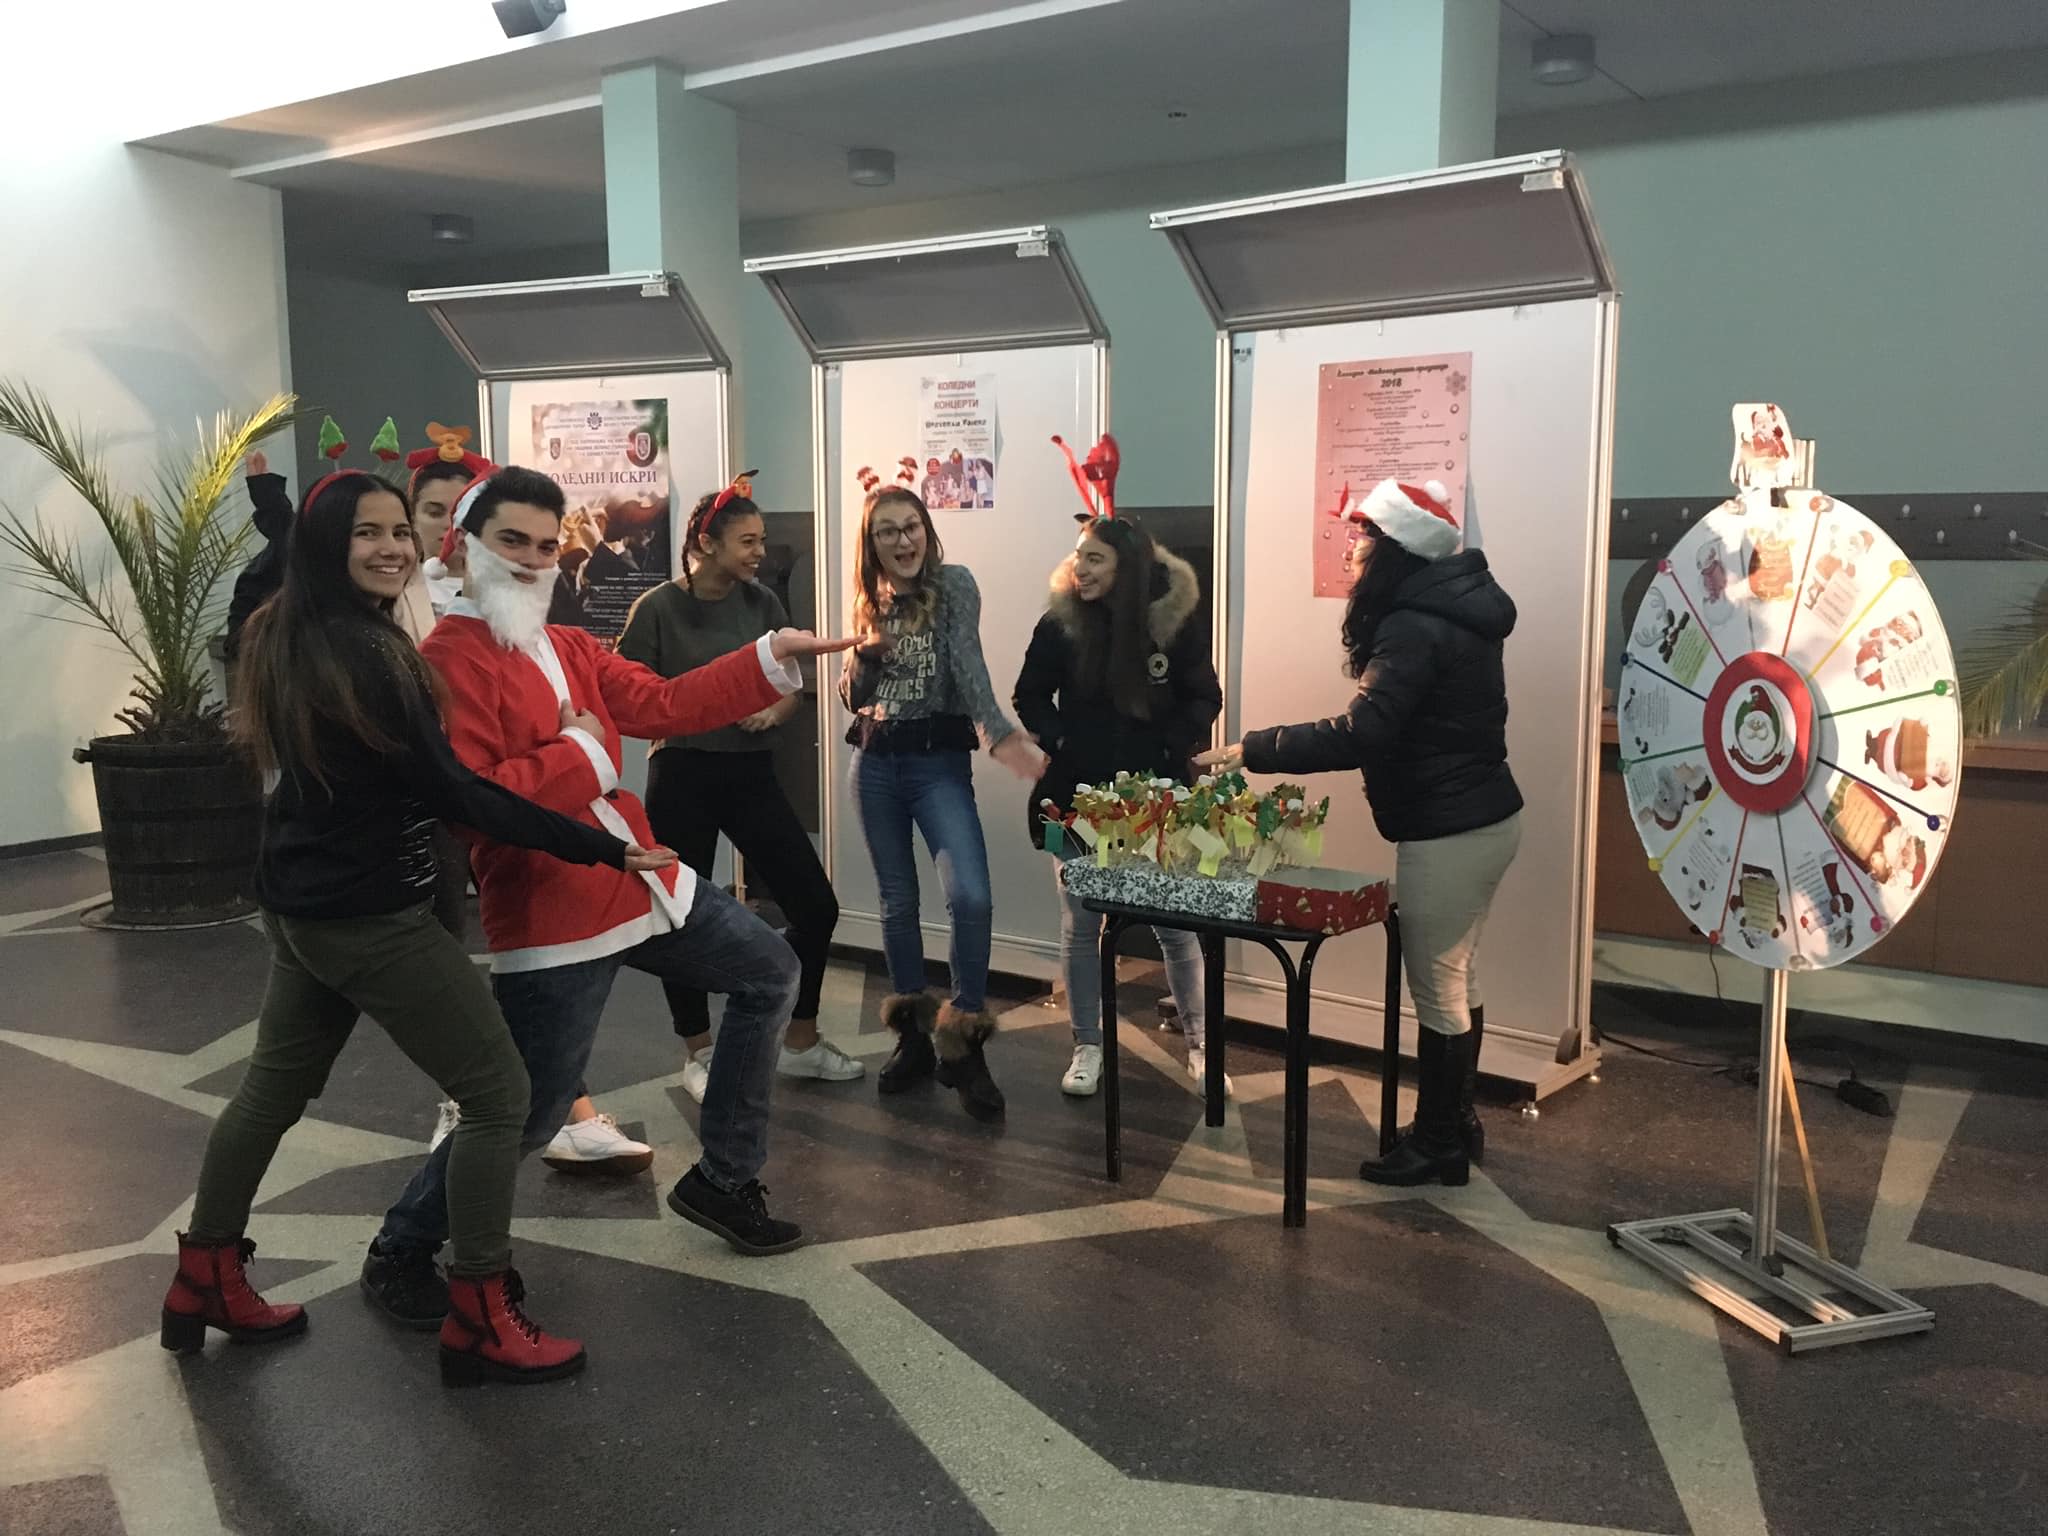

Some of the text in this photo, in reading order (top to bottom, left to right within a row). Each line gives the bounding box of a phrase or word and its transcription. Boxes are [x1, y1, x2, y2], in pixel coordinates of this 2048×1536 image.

[934, 400, 979, 410] КОНЦЕРТИ
[549, 470, 657, 485] ОЛЕДНИ ИСКРИ
[918, 652, 937, 678] 23
